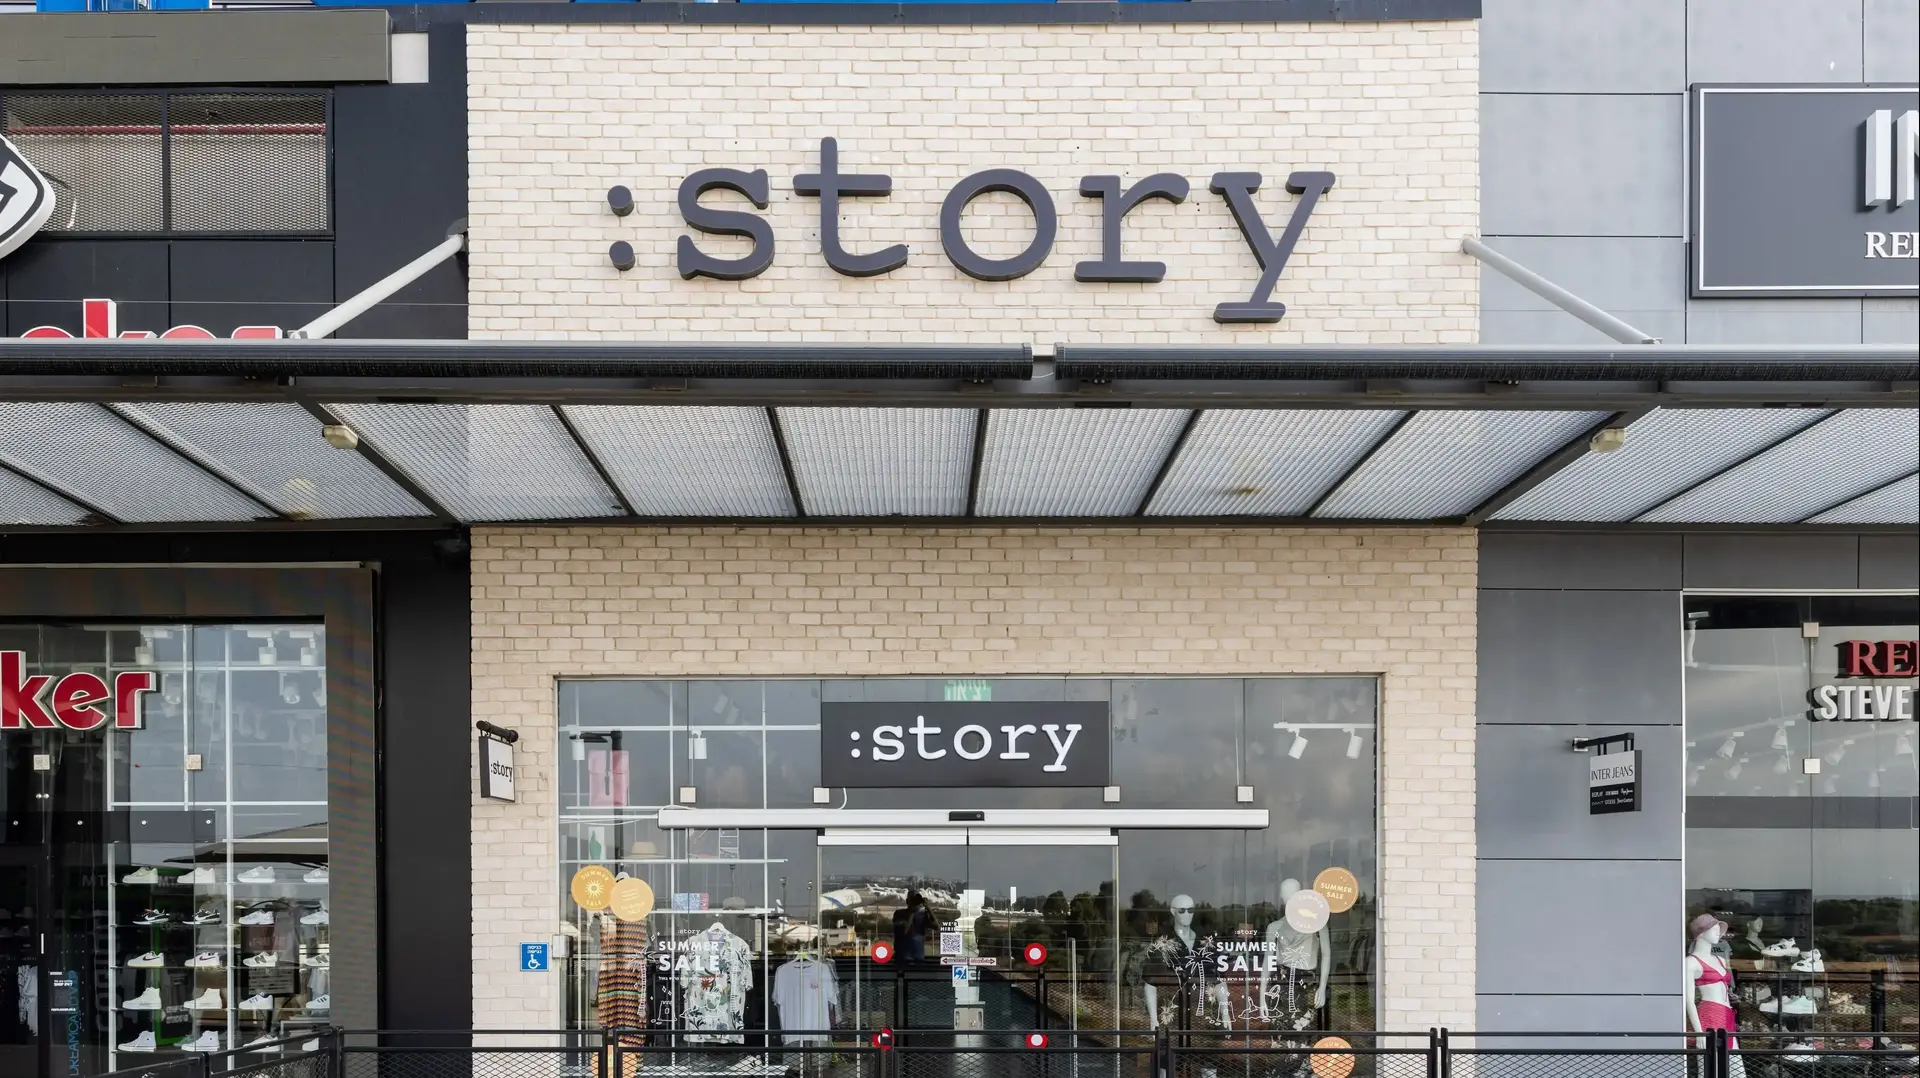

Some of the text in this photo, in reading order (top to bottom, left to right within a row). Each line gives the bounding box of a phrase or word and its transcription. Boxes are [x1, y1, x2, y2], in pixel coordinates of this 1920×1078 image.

[607, 136, 1335, 323] :story
[1816, 685, 1912, 721] STEVE
[850, 715, 1083, 773] :story
[490, 760, 513, 783] :story
[1591, 764, 1634, 781] INTER JEANS
[580, 870, 609, 882] SUMMER
[1320, 882, 1353, 894] SUMMER
[1326, 891, 1344, 900] SALE
[677, 928, 701, 936] :story
[658, 941, 720, 951] SUMMER
[1216, 941, 1277, 952] SUMMER
[658, 954, 720, 971] SALE
[1216, 955, 1278, 972] SALE
